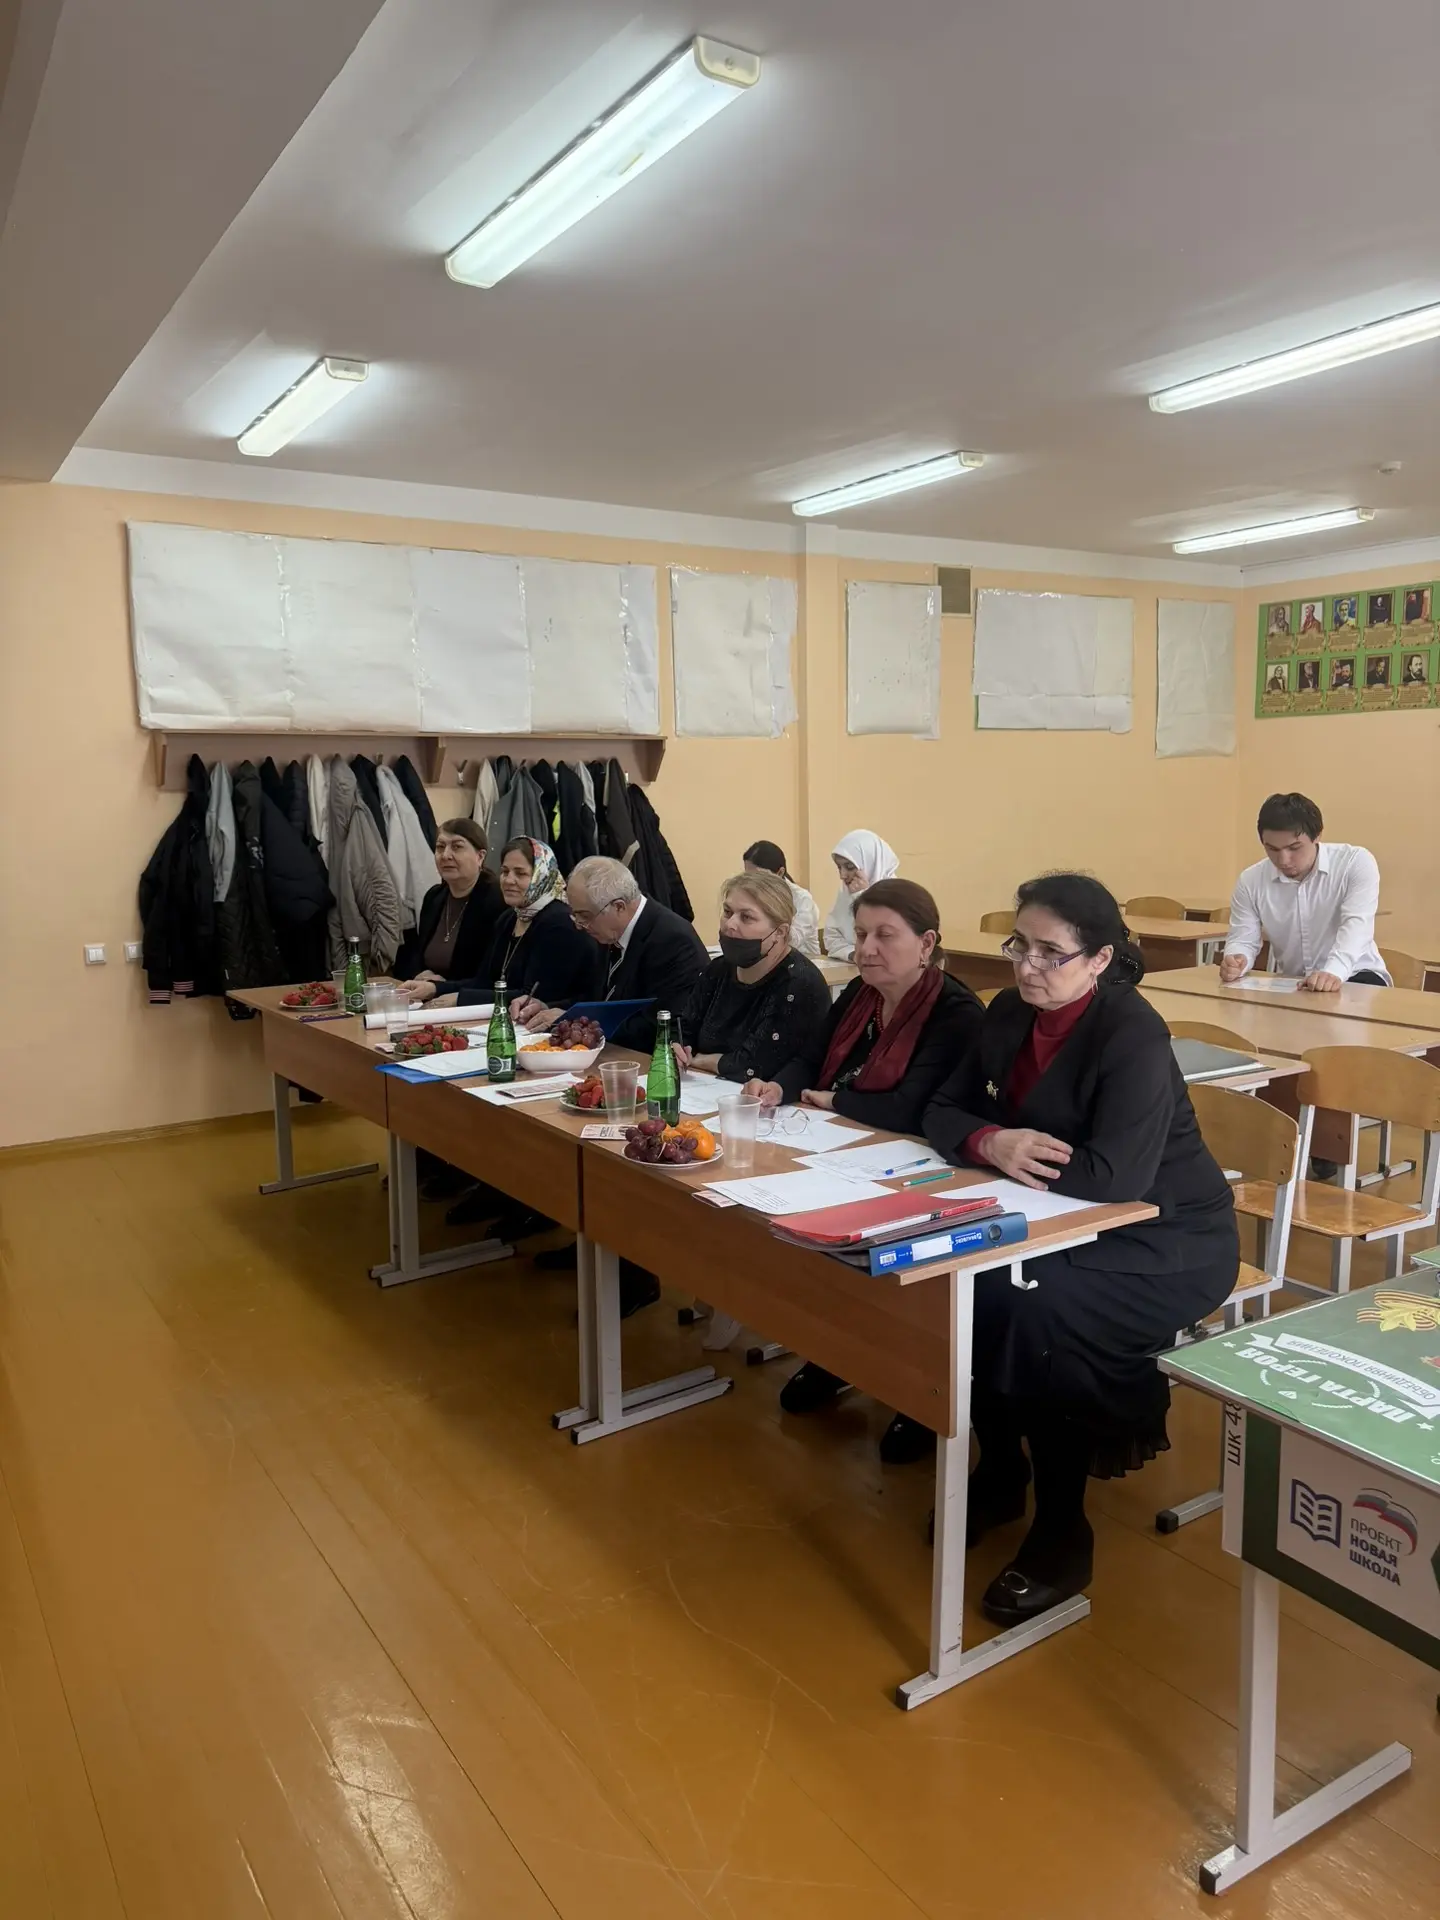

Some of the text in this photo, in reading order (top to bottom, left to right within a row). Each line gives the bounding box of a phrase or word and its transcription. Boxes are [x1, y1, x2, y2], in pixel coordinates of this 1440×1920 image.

[1235, 1347, 1416, 1423] ПАРТА ГЕРОЯ
[1287, 1339, 1437, 1401] ОБЪЕДИНЯЯ ПОКОЛЕНИЯ
[1350, 1518, 1403, 1552] ПРОЕКТ
[1350, 1533, 1398, 1568] НОВАЯ
[1349, 1549, 1401, 1586] ШКОЛА
